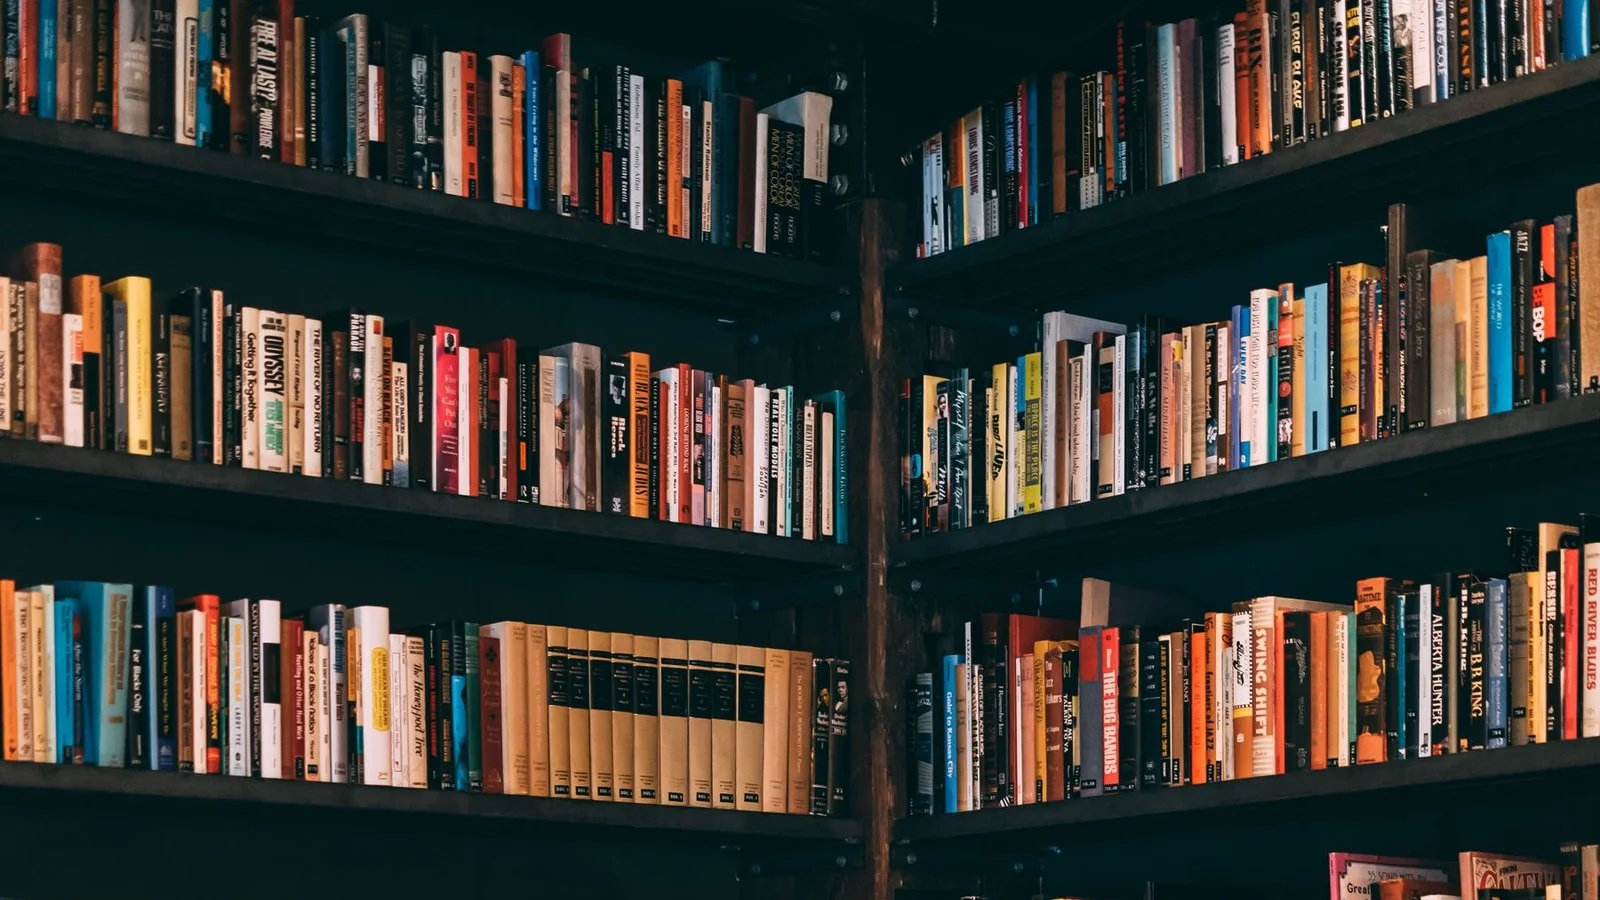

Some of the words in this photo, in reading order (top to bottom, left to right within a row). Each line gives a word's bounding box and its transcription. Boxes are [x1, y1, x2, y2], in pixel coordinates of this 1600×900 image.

[1435, 0, 1446, 11] AT
[257, 19, 276, 46] FREE
[257, 47, 276, 63] AT
[1435, 45, 1446, 76] COLE
[257, 64, 276, 101] LAST?
[1004, 102, 1015, 125] LOUIS
[259, 107, 273, 148] POWLEDGE
[968, 128, 978, 149] LOUIS
[771, 129, 779, 154] MEN
[785, 131, 793, 156] MEN
[1004, 126, 1015, 172] ARMSTRONG
[658, 160, 665, 170] OF
[771, 154, 779, 168] OF
[785, 157, 793, 170] OF
[968, 151, 978, 196] ARMSTRONG
[658, 173, 665, 181] A
[771, 169, 779, 204] COLOR
[785, 172, 793, 207] COLOR
[1517, 231, 1528, 254] JAZZ
[1415, 264, 1426, 280] The
[1415, 283, 1426, 319] Making
[1415, 322, 1426, 332] of
[245, 333, 256, 369] Getting
[1415, 335, 1426, 357] Jazz
[264, 336, 284, 396] ODYSSEY
[313, 376, 320, 391] OF
[383, 378, 390, 390] ON
[245, 377, 256, 423] Together
[313, 396, 320, 411] NO
[635, 382, 649, 414] BLACK
[951, 390, 967, 430] Myself
[991, 414, 1004, 441] BIRD
[1030, 403, 1039, 428] SPACE
[1030, 440, 1039, 455] THE
[991, 442, 1004, 481] LIVES
[1030, 457, 1039, 481] PLACE
[938, 465, 947, 501] Mills
[1587, 568, 1597, 596] RED
[20, 607, 30, 627] The
[1587, 601, 1597, 640] RIVER
[252, 604, 260, 661] CONVICTED
[1433, 614, 1442, 671] ALBERTA
[74, 642, 82, 661] After
[132, 649, 142, 662] For
[1255, 628, 1267, 684] SWING
[74, 664, 82, 674] the
[132, 666, 142, 691] Blacks
[252, 662, 260, 674] IN
[308, 666, 315, 675] of
[414, 664, 424, 678] The
[1587, 646, 1597, 690] BLUES
[74, 677, 82, 701] Storm
[252, 676, 260, 693] THE
[1104, 670, 1116, 696] THE
[20, 699, 30, 710] of
[132, 694, 142, 712] Only
[252, 696, 260, 725] WOMB
[414, 680, 424, 734] Honey-pod
[946, 692, 954, 715] Goin'
[1104, 699, 1116, 724] BIG
[1255, 687, 1267, 736] SHIFT
[1433, 674, 1442, 726] HUNTER
[1471, 681, 1482, 718] KING
[20, 713, 30, 739] Race
[946, 716, 954, 726] to
[1206, 715, 1213, 724] of
[414, 737, 424, 757] Tree
[946, 728, 954, 756] Kansas
[1104, 726, 1116, 774] BANDS
[946, 758, 954, 778] City
[1499, 864, 1518, 876] FROM
